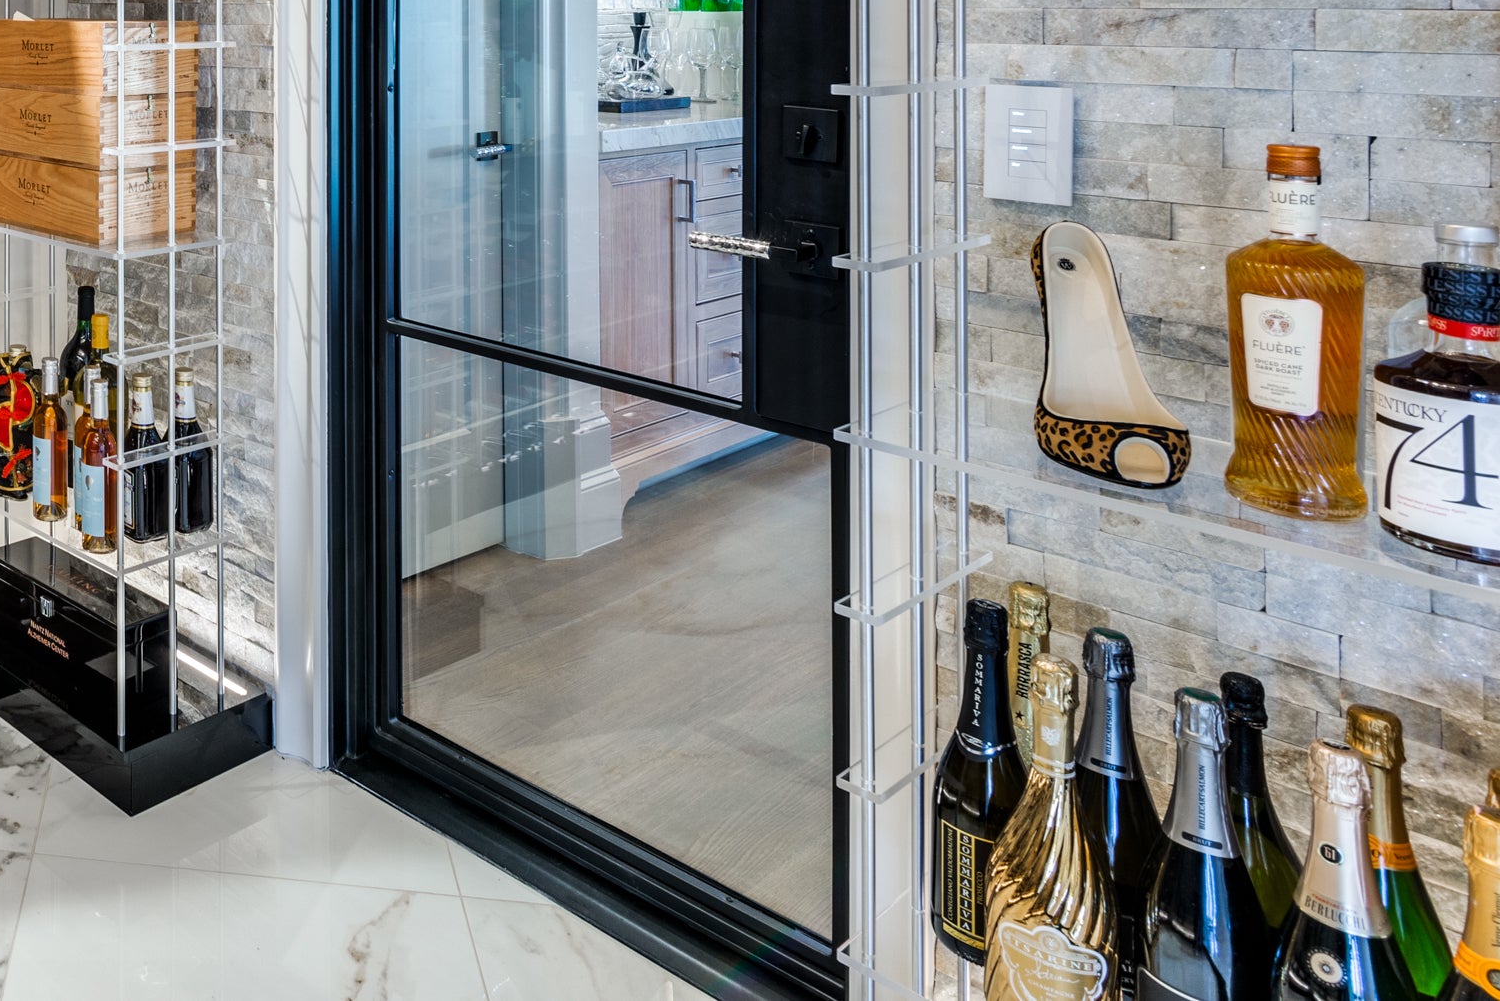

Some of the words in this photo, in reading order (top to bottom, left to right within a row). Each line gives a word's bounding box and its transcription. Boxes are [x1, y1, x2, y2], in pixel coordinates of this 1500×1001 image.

[21, 39, 54, 52] MORLET
[19, 108, 52, 124] MORLET
[127, 108, 169, 121] MORLET
[17, 176, 51, 195] MORLET
[126, 181, 169, 194] MORLET
[1252, 339, 1303, 356] FLUÈRE
[1376, 392, 1449, 424] ENTUCKY
[1376, 412, 1500, 511] 74
[30, 619, 45, 635] NANTZ
[44, 629, 66, 648] NATIONAL
[51, 642, 70, 660] CENTER
[971, 653, 984, 727] SOMMARIVA
[961, 835, 971, 931] SOMMARIVA
[1304, 895, 1367, 931] BERLUCCHI
